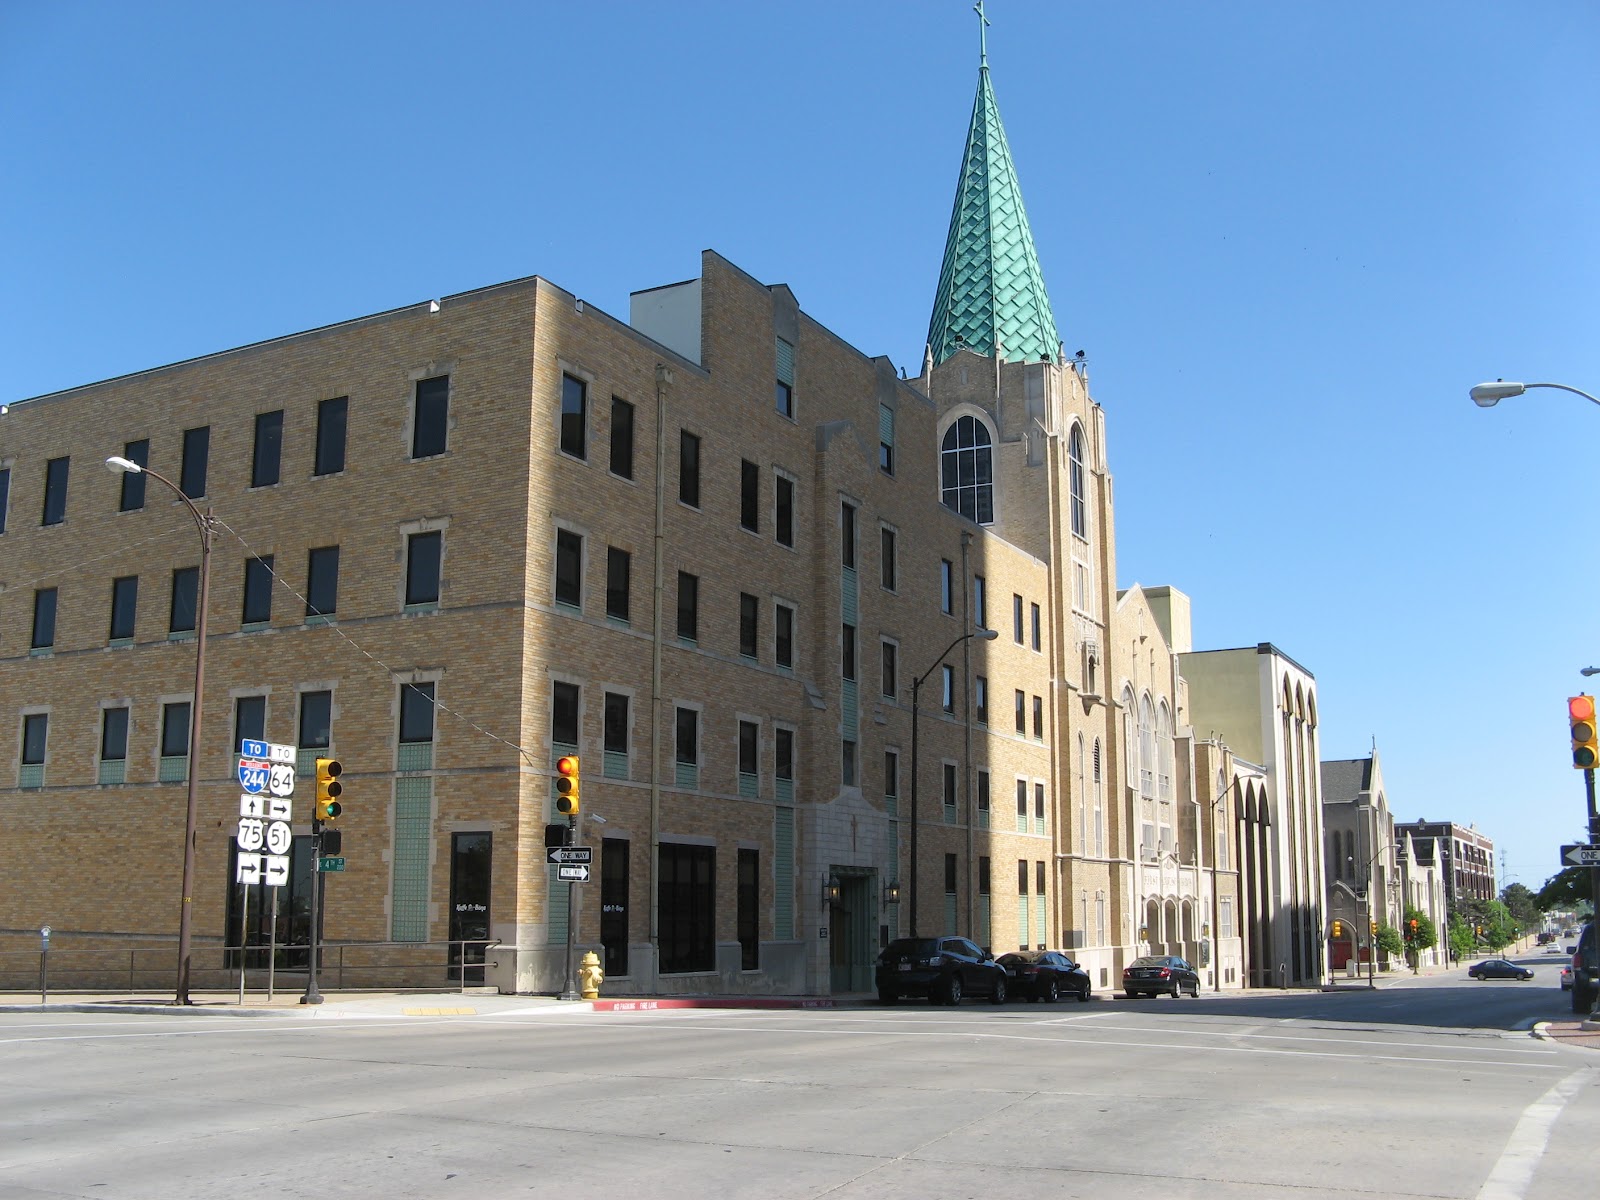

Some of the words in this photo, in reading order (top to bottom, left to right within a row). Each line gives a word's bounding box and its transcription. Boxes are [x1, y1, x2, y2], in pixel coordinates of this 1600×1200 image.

[249, 744, 261, 754] TO
[277, 748, 290, 759] TO
[243, 769, 265, 788] 244
[272, 771, 291, 790] 64
[241, 824, 260, 844] 75
[271, 828, 286, 847] 51
[1581, 851, 1598, 860] ONE
[562, 868, 572, 876] ONE
